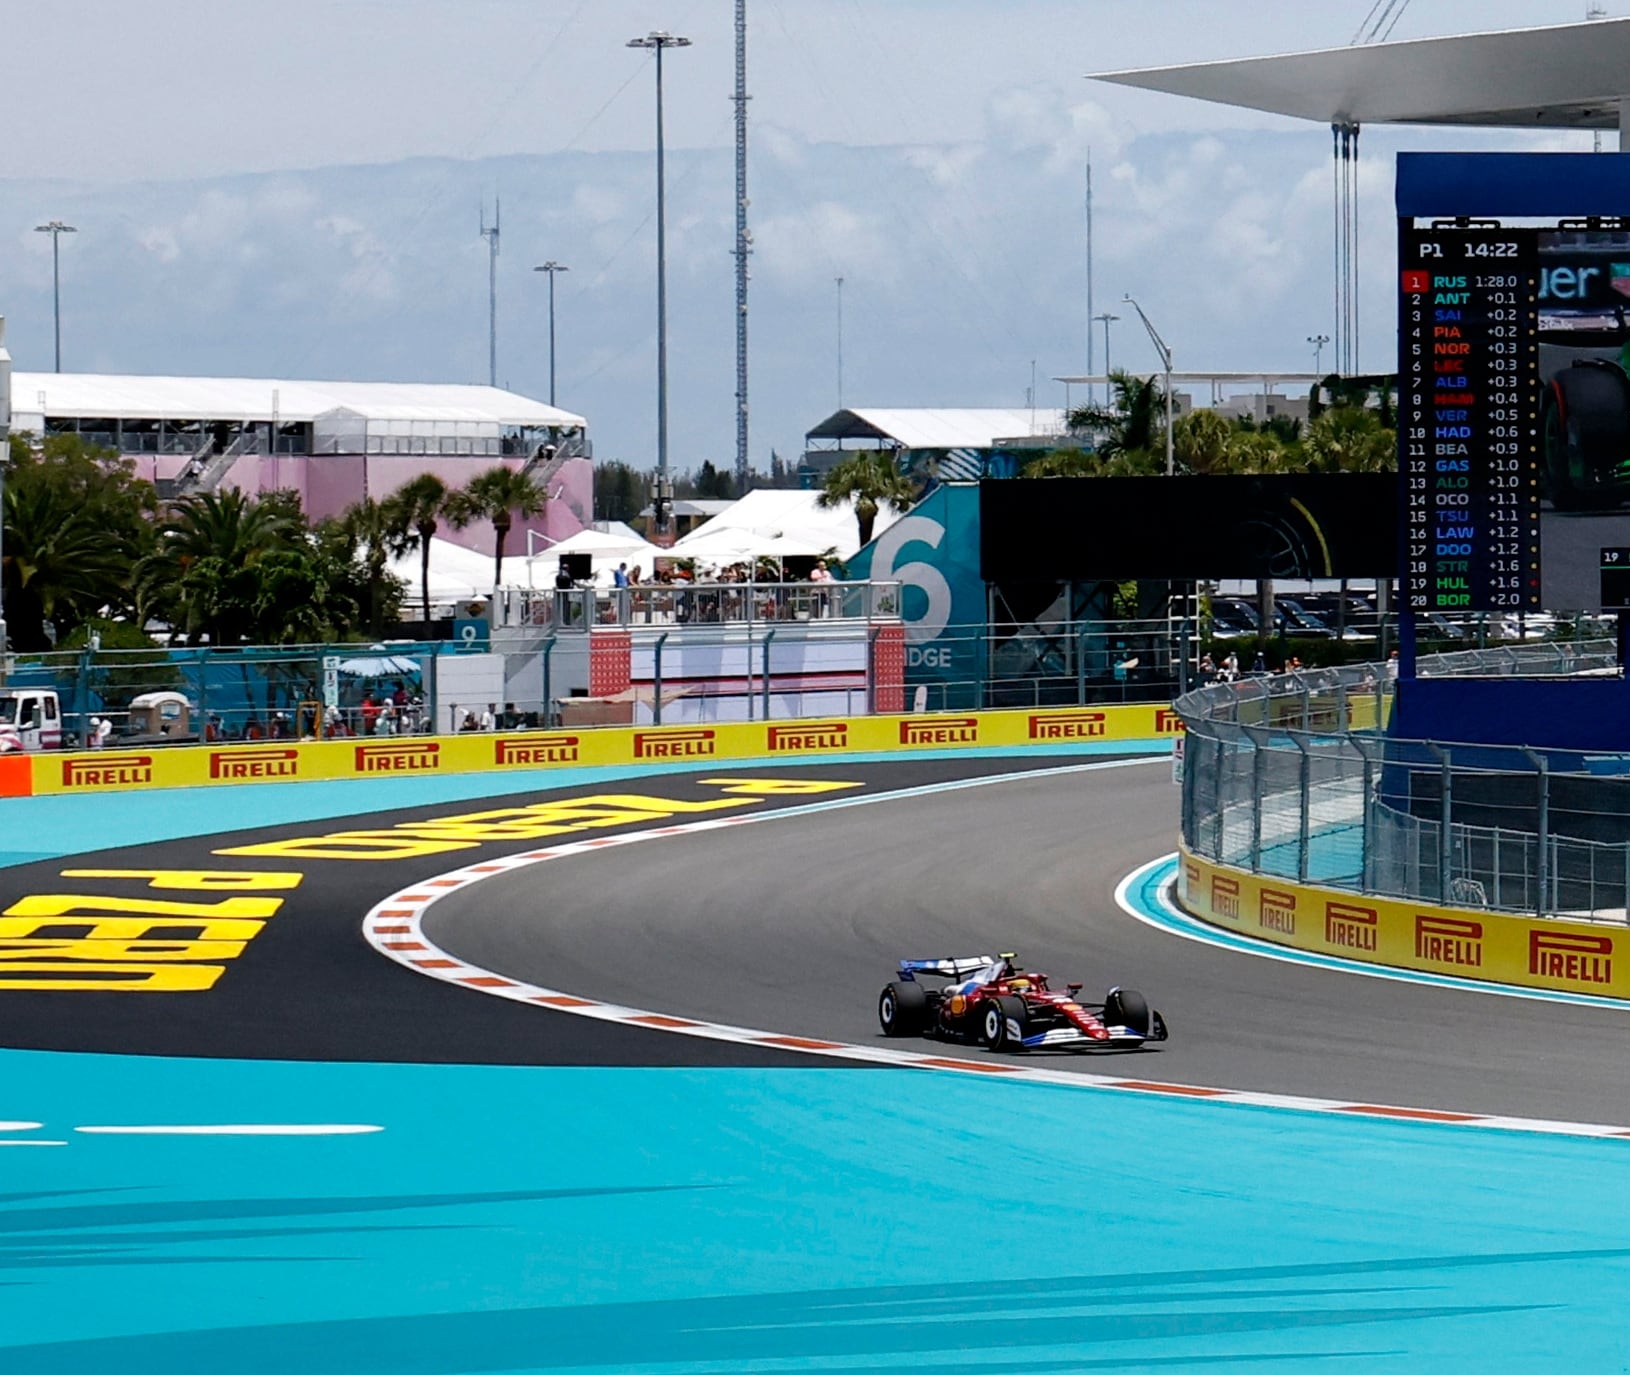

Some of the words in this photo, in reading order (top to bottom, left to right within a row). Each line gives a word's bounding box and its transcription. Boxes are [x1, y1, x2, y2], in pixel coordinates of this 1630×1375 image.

[1419, 243, 1444, 258] P1
[1464, 243, 1518, 258] 14:22
[1412, 276, 1421, 288] 1
[1435, 276, 1467, 287] RUS
[1476, 275, 1518, 287] 1:28.0
[1412, 294, 1421, 304] 2
[1435, 292, 1471, 304] ANT
[1488, 292, 1516, 304] +0.1
[1413, 310, 1421, 321] 3
[1435, 309, 1462, 321] SAI
[1488, 308, 1517, 320] +0.2
[1413, 327, 1421, 337] 4
[1434, 326, 1461, 337] PIA
[1488, 325, 1517, 337] +0.2
[1413, 343, 1422, 355] 5
[1435, 342, 1471, 354] NOR
[1488, 342, 1517, 353] +0.3
[1413, 360, 1422, 371] 6
[1488, 358, 1518, 370] +0.3
[1413, 377, 1422, 387] 7
[1436, 375, 1468, 387] ALB
[1488, 375, 1517, 387] +0.3
[1413, 393, 1422, 405] 8
[1488, 392, 1519, 404] +0.4
[1413, 410, 1422, 421] 9
[1436, 409, 1468, 421] VER
[1489, 408, 1518, 420] +0.5
[1410, 427, 1426, 438] 10
[1436, 426, 1472, 437] HAD
[1489, 425, 1519, 437] +0.6
[1410, 444, 1426, 455] 11
[1436, 443, 1468, 455] BEA
[1489, 442, 1519, 454] +0.9
[1411, 460, 1426, 472] 12
[1436, 459, 1470, 471] GAS
[1489, 459, 1519, 470] +1.0
[1410, 477, 1426, 488] 13
[1437, 476, 1469, 488] ALO
[1489, 475, 1519, 487] +1.0
[1410, 494, 1426, 505] 14
[1436, 493, 1470, 505] OCO
[1490, 492, 1518, 504] +1.1
[1411, 510, 1427, 522] 15
[1436, 510, 1469, 522] TSU
[1490, 509, 1519, 521] +1.1
[1411, 528, 1427, 539] 16
[1437, 526, 1474, 538] LAW
[1490, 526, 1519, 537] +1.2
[1411, 544, 1427, 556] 17
[1437, 543, 1472, 555] DOO
[1490, 542, 1519, 554] +1.2
[1604, 552, 1619, 562] 19
[1411, 561, 1427, 572] 18
[1437, 560, 1469, 572] STR
[1490, 559, 1520, 571] +1.6
[870, 516, 952, 645] 6
[1411, 578, 1427, 589] 19
[1437, 577, 1469, 588] HUL
[1490, 576, 1520, 588] +1.6
[1411, 595, 1427, 606] 20
[1437, 593, 1471, 605] BOR
[1491, 593, 1520, 604] +2.0
[462, 625, 477, 648] 9
[60, 755, 154, 787] PIRELLI
[209, 748, 300, 779] PIRELLI
[354, 741, 441, 773] PIRELLI
[495, 735, 581, 766] PIRELLI
[633, 729, 716, 758] PIRELLI
[767, 722, 849, 751] PIRELLI
[899, 717, 978, 745] PIRELLI
[1028, 712, 1106, 739] PIRELLI
[1260, 888, 1297, 935] PIRELLI
[1325, 901, 1378, 952] PIRELLI
[1414, 914, 1484, 967] PIRELLI
[1528, 928, 1613, 985] PIRELLI
